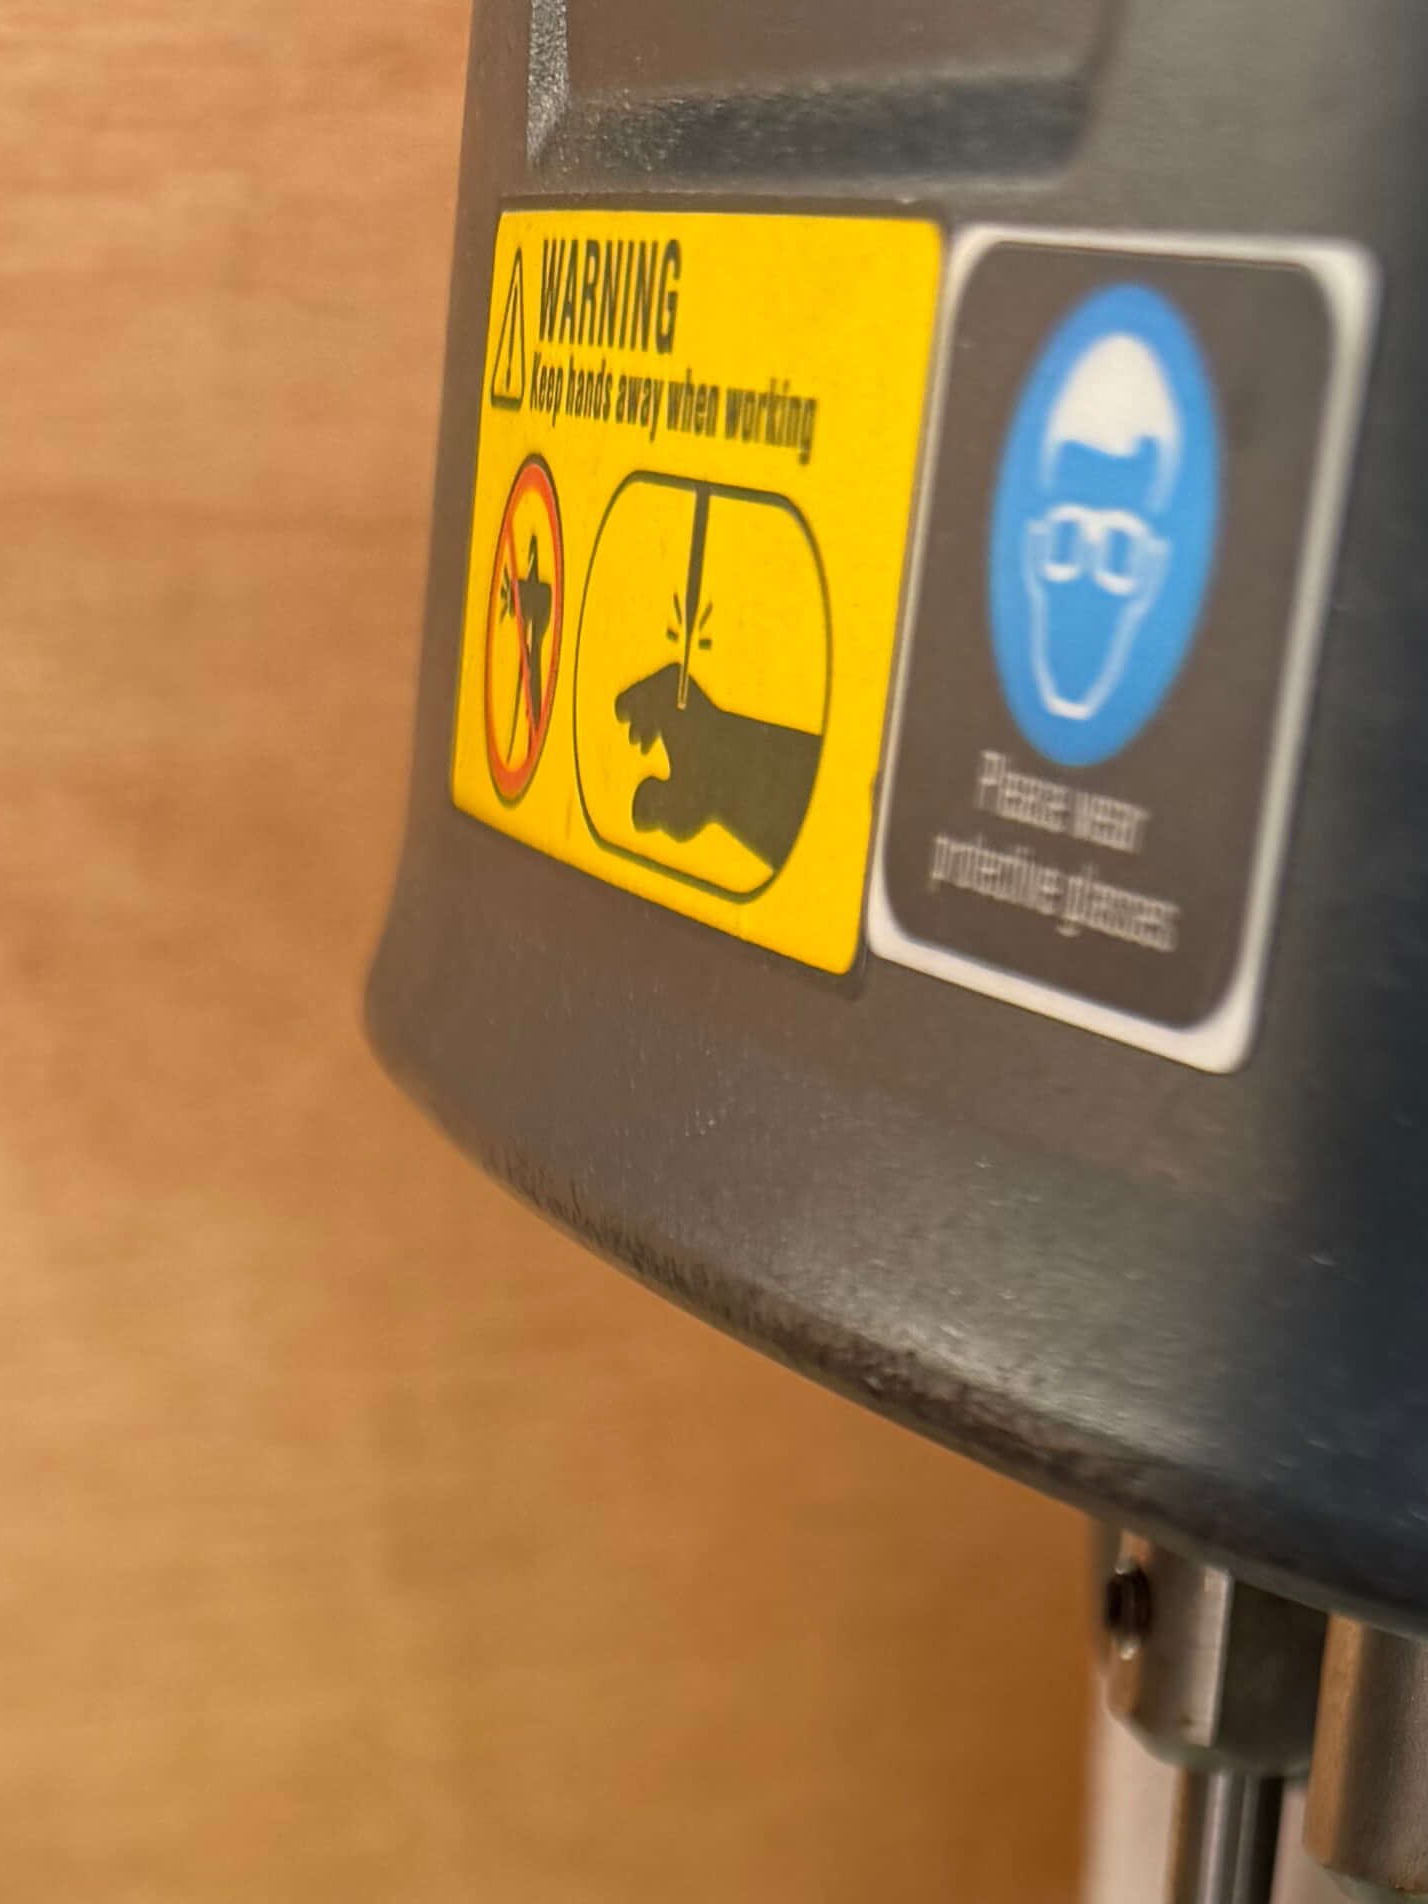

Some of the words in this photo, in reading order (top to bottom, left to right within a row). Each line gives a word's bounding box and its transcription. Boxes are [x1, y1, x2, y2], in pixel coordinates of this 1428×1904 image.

[539, 238, 681, 354] WARNING
[530, 350, 564, 428] Keep
[566, 354, 613, 422] hands
[616, 374, 664, 443] away
[667, 366, 720, 437] when
[724, 376, 818, 466] working
[977, 748, 1069, 833] Please
[1071, 791, 1151, 854] wear
